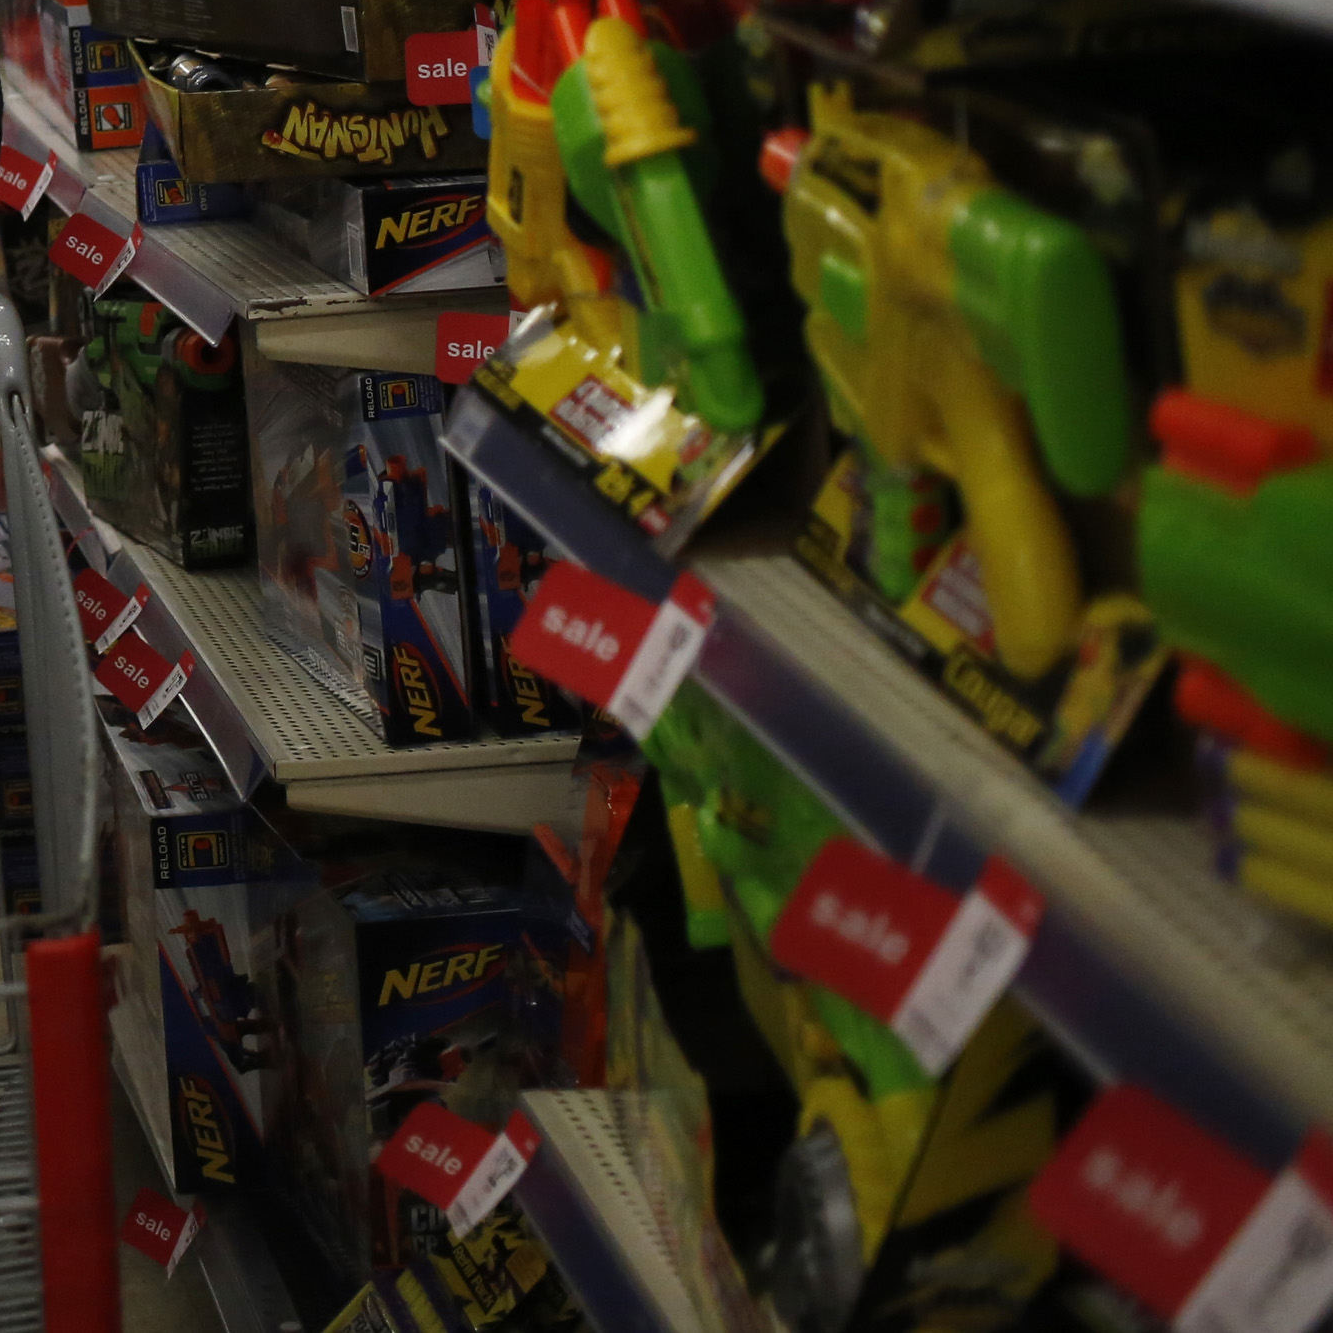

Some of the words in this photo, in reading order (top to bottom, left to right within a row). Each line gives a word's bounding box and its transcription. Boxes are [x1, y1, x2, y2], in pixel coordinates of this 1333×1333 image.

[74, 28, 83, 75] RELOAD
[417, 57, 467, 79] sale
[78, 90, 89, 135] RELOAD
[280, 102, 448, 167] HUNTSMAN
[375, 194, 483, 249] NERF
[65, 234, 104, 266] sale
[447, 340, 496, 360] sale
[367, 377, 375, 418] RELOAD
[75, 589, 107, 620] sale
[541, 604, 621, 663] sale
[113, 654, 149, 689] sale
[392, 645, 443, 738] NERF
[187, 772, 208, 801] ELITE
[161, 826, 170, 880] RELOAD
[808, 888, 912, 966] sale
[377, 942, 505, 1007] NERF
[178, 1074, 237, 1184] NERF
[404, 1134, 463, 1177] sale
[1078, 1141, 1206, 1252] sale
[135, 1211, 171, 1241] sale
[453, 1244, 478, 1278] Refill
[474, 1272, 495, 1308] Pack
